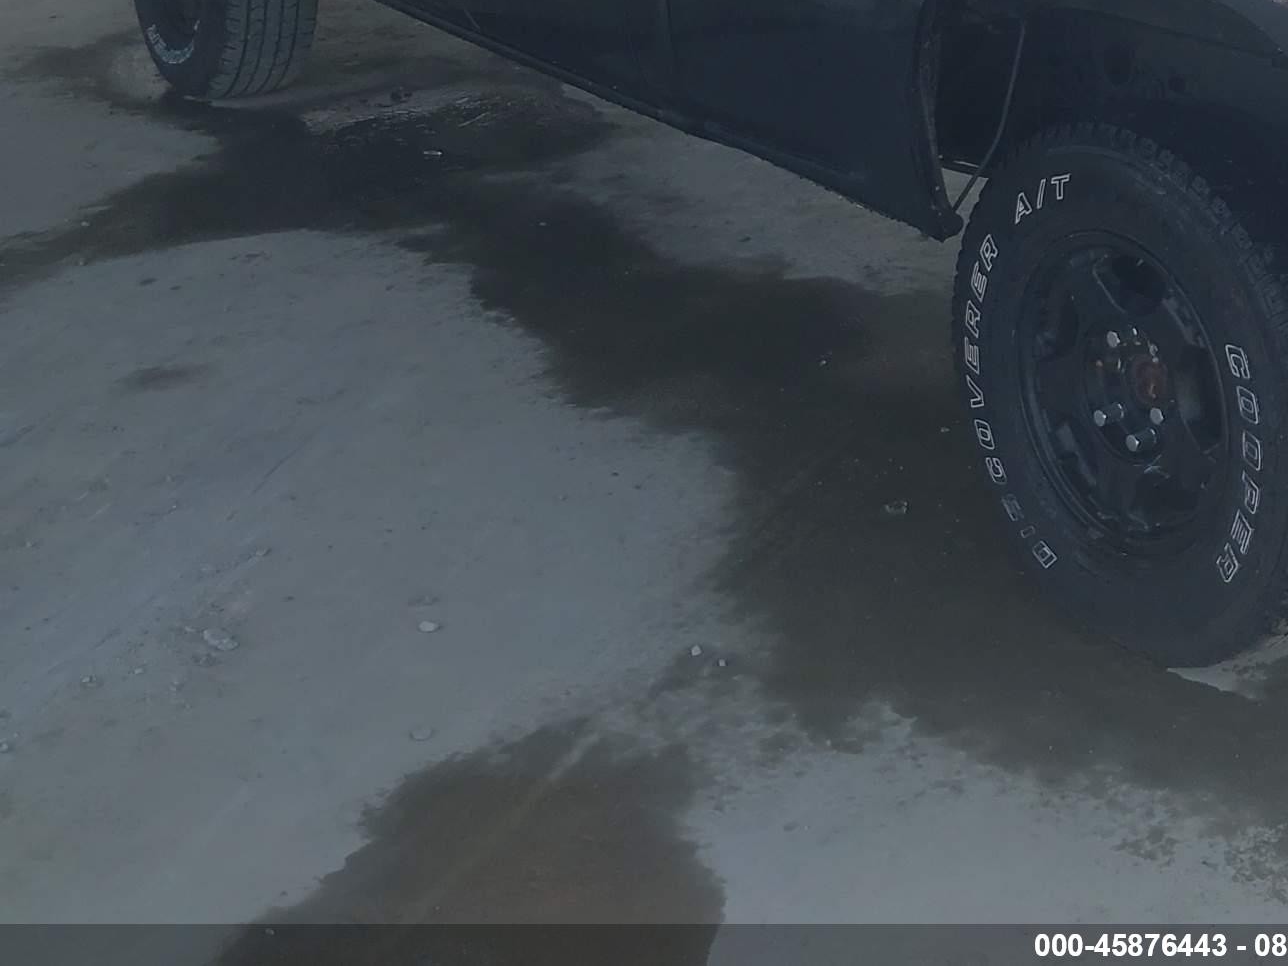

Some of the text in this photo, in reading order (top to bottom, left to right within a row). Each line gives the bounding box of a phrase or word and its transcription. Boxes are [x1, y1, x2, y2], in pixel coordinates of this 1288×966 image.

[964, 173, 1071, 569] DISCOVERER A/T
[1215, 344, 1261, 583] COOPER
